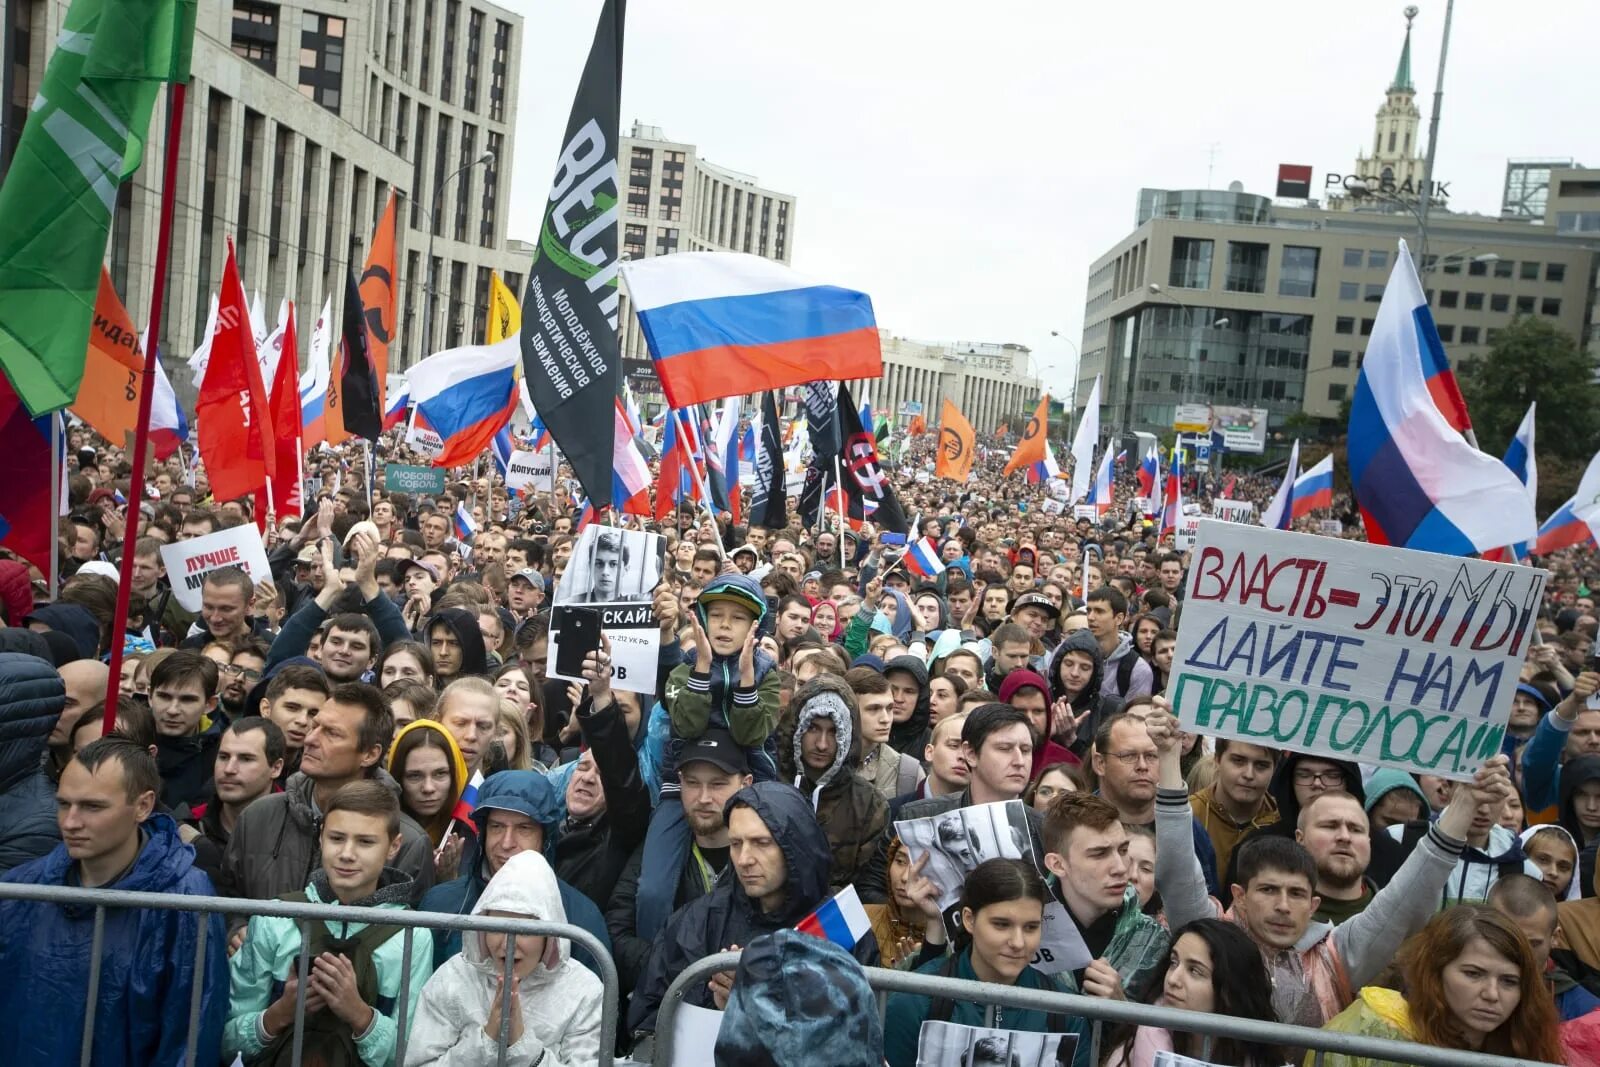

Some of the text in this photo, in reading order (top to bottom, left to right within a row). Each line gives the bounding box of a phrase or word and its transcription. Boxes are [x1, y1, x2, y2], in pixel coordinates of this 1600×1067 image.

[531, 275, 591, 388] демократическое
[552, 288, 608, 376] Молодёжное
[532, 332, 574, 399] движение
[393, 470, 436, 481] ЛЮБОВЬ
[399, 479, 438, 489] СОБОЛЬ
[185, 546, 240, 573] ЛУЧШЕ
[1184, 615, 1505, 719] ДАЙТЕ НАМ
